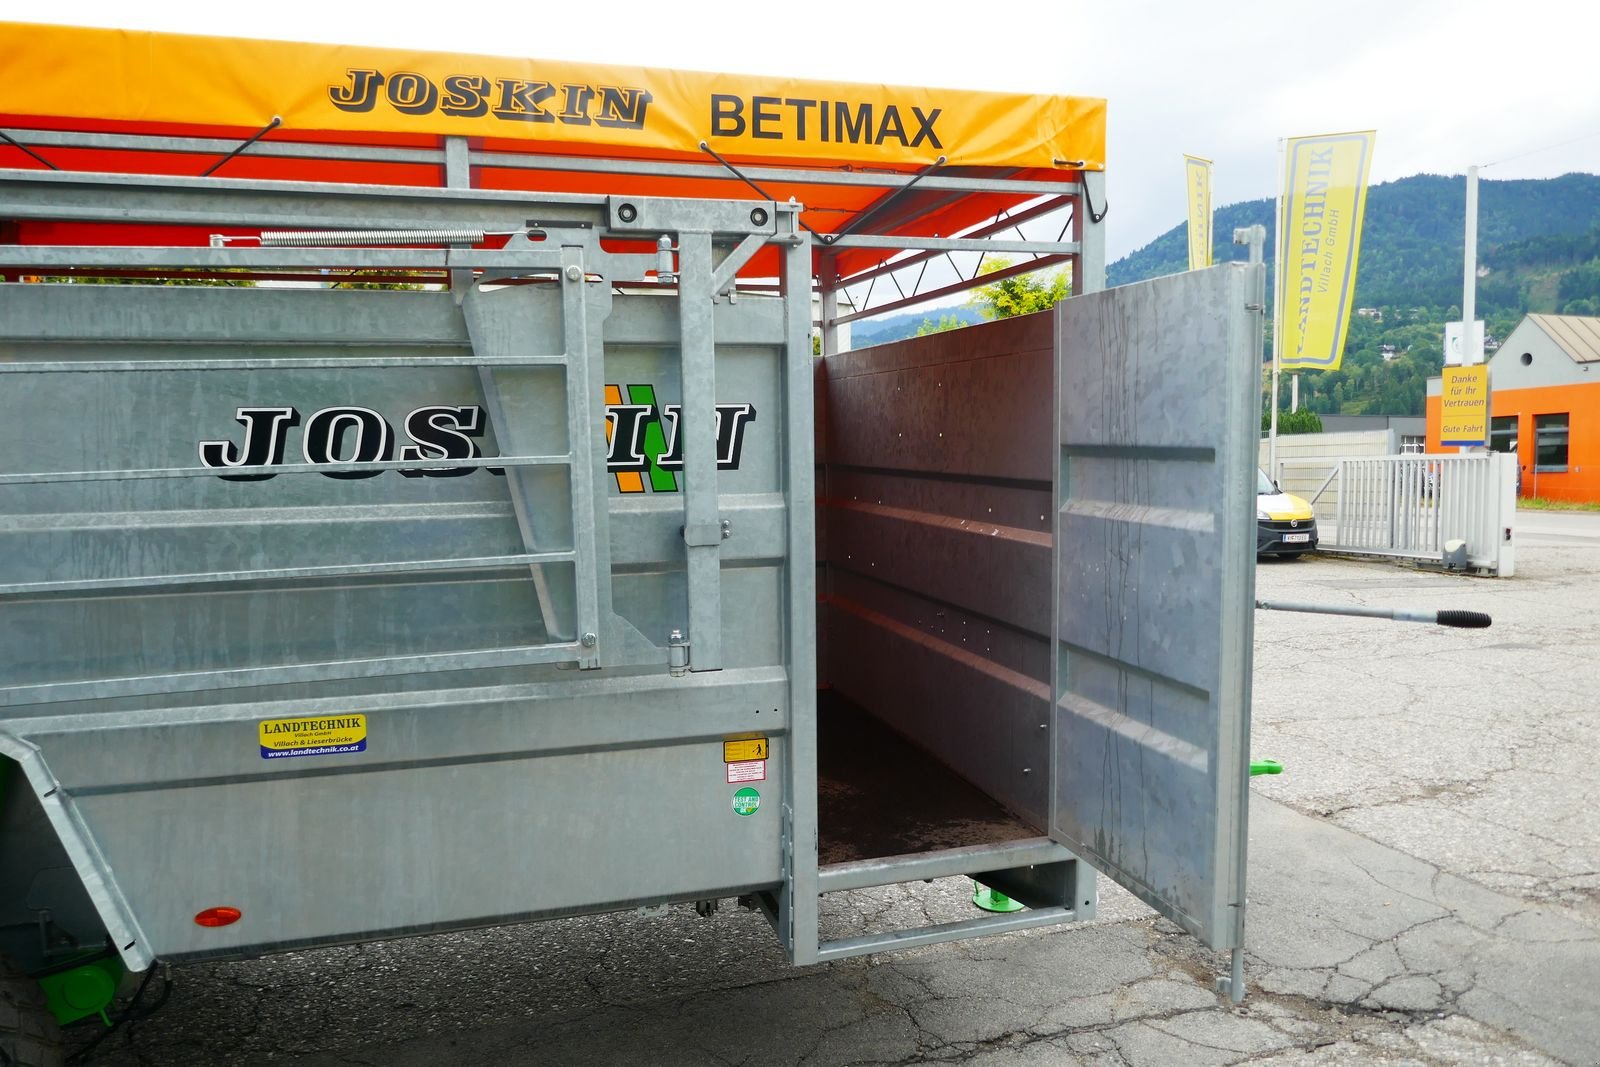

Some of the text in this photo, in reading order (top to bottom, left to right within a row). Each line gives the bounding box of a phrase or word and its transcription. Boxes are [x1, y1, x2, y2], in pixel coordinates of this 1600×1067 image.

[328, 68, 944, 149] JOSKIN BETIMAX
[1318, 209, 1340, 293] Villach GmbH
[1451, 374, 1478, 384] Danke
[1450, 385, 1477, 396] für Ihr
[1443, 398, 1485, 408] Vertrauen
[1442, 423, 1484, 433] Gute Fahrt
[198, 403, 757, 481] JOSIN
[263, 717, 361, 734] LANDTECHNIK
[273, 739, 299, 747] Villach
[307, 736, 353, 745] Lieserbrücke
[267, 745, 359, 758] www.landtechnik.co.at
